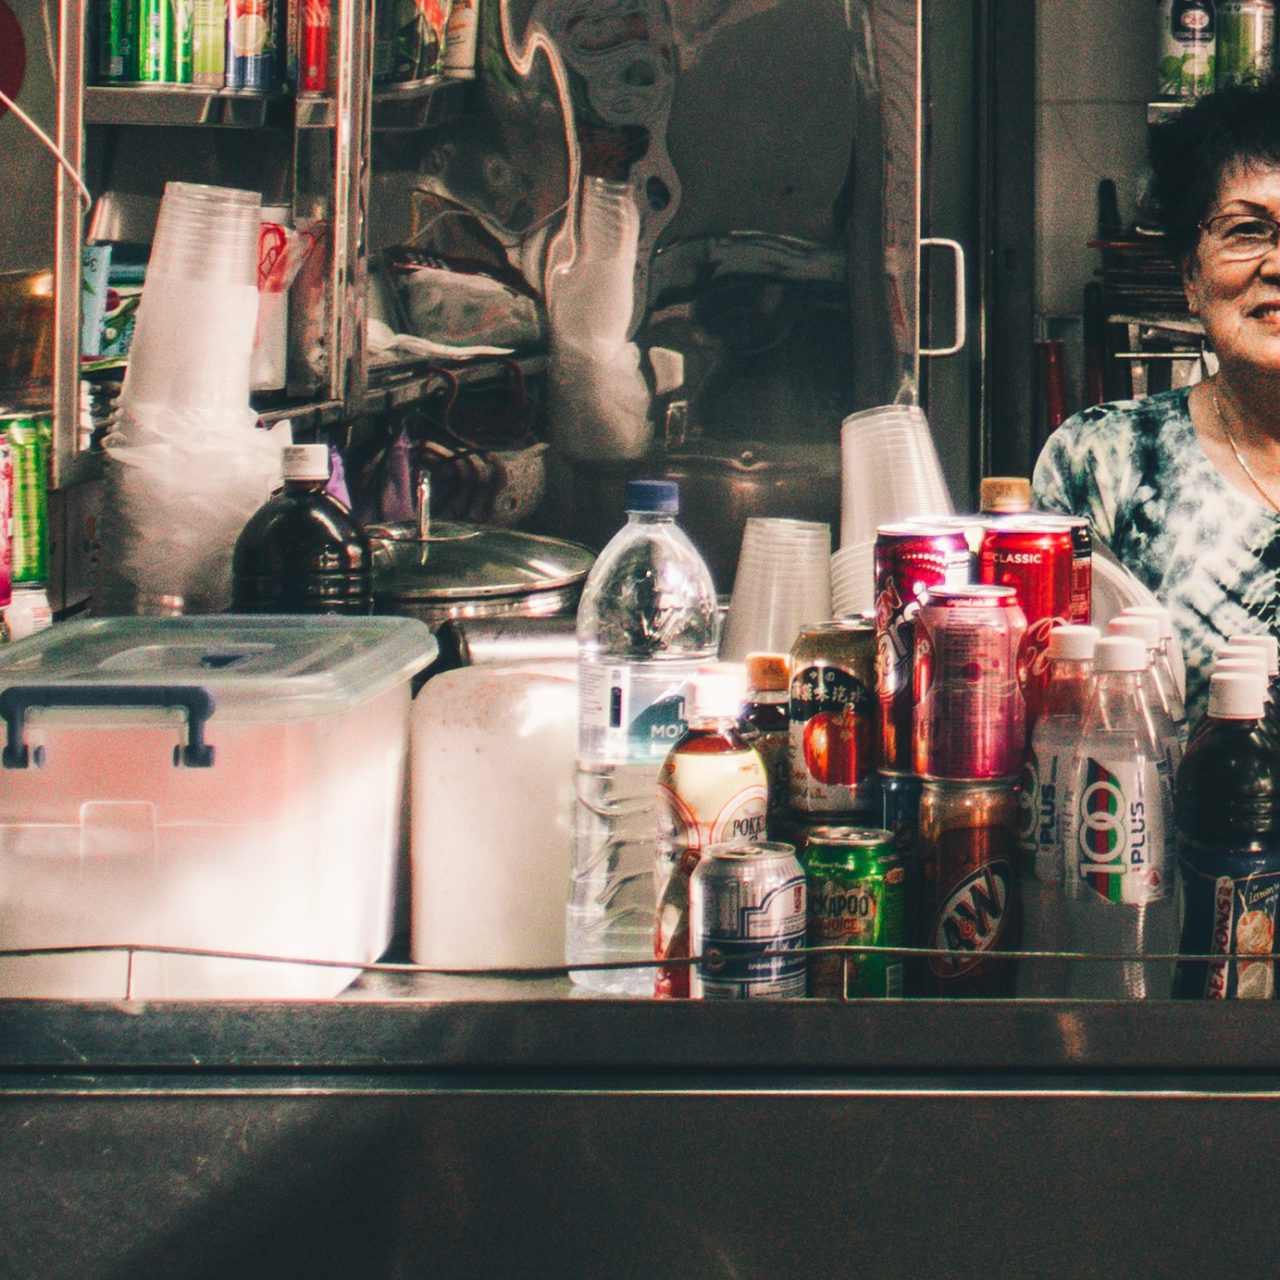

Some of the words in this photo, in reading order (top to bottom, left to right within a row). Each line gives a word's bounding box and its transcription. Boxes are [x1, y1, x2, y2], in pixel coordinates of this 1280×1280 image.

[992, 553, 1042, 565] CLASSIC
[732, 816, 766, 836] POKK
[1078, 780, 1127, 878] 100
[1130, 800, 1146, 867] PLUS
